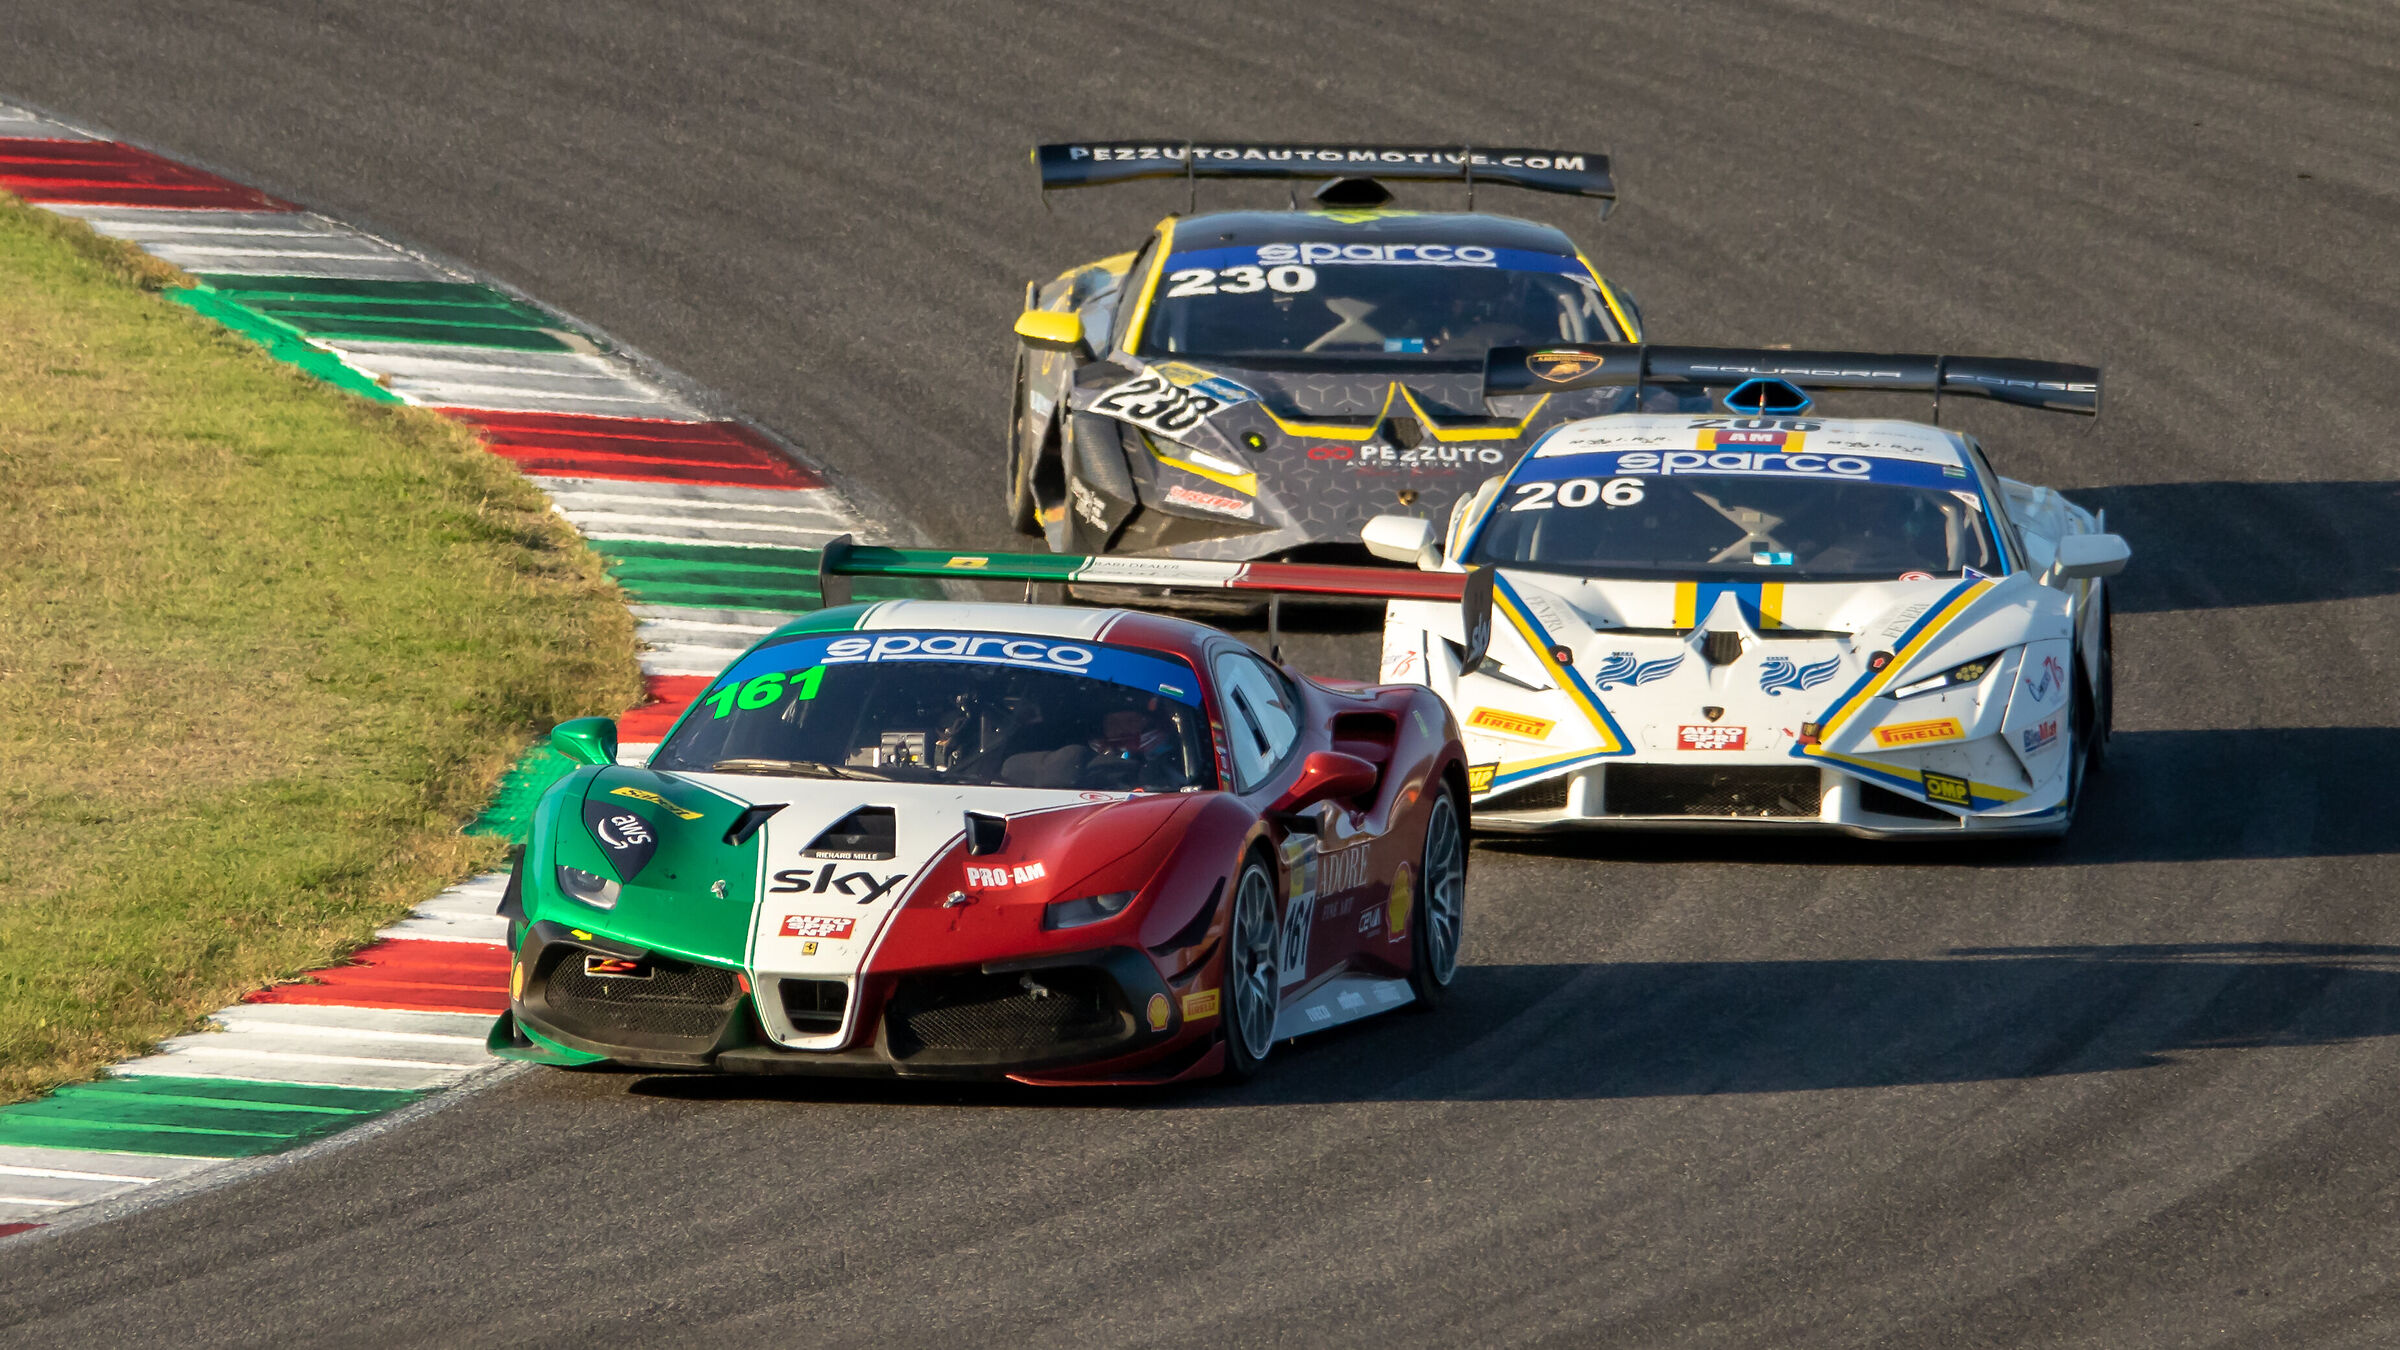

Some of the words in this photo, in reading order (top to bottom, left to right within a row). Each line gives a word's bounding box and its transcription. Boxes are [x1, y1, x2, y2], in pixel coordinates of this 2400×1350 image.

[1069, 147, 1585, 171] PEZZUTOAUTOMOTIVE.COM
[1256, 242, 1496, 266] sparco
[1166, 265, 1317, 298] 230
[1095, 377, 1219, 431] 230
[1728, 432, 1773, 442] AM
[1360, 446, 1504, 464] PEZZUTO
[1616, 451, 1872, 477] sparco
[1510, 477, 1646, 513] 206
[825, 636, 1094, 667] sparco
[705, 664, 828, 719] 161
[1473, 711, 1546, 736] PIRELLI
[1680, 727, 1744, 735] AUTO
[1880, 722, 1955, 743] PIRELLI
[1927, 779, 1968, 799] OMP
[611, 815, 652, 845] aws
[815, 851, 851, 859] RICHARD
[966, 862, 1046, 887] PRO-AM
[1318, 843, 1371, 898] ADORE
[768, 863, 909, 905] sky
[785, 916, 852, 925] AUTO
[1284, 896, 1314, 973] 161
